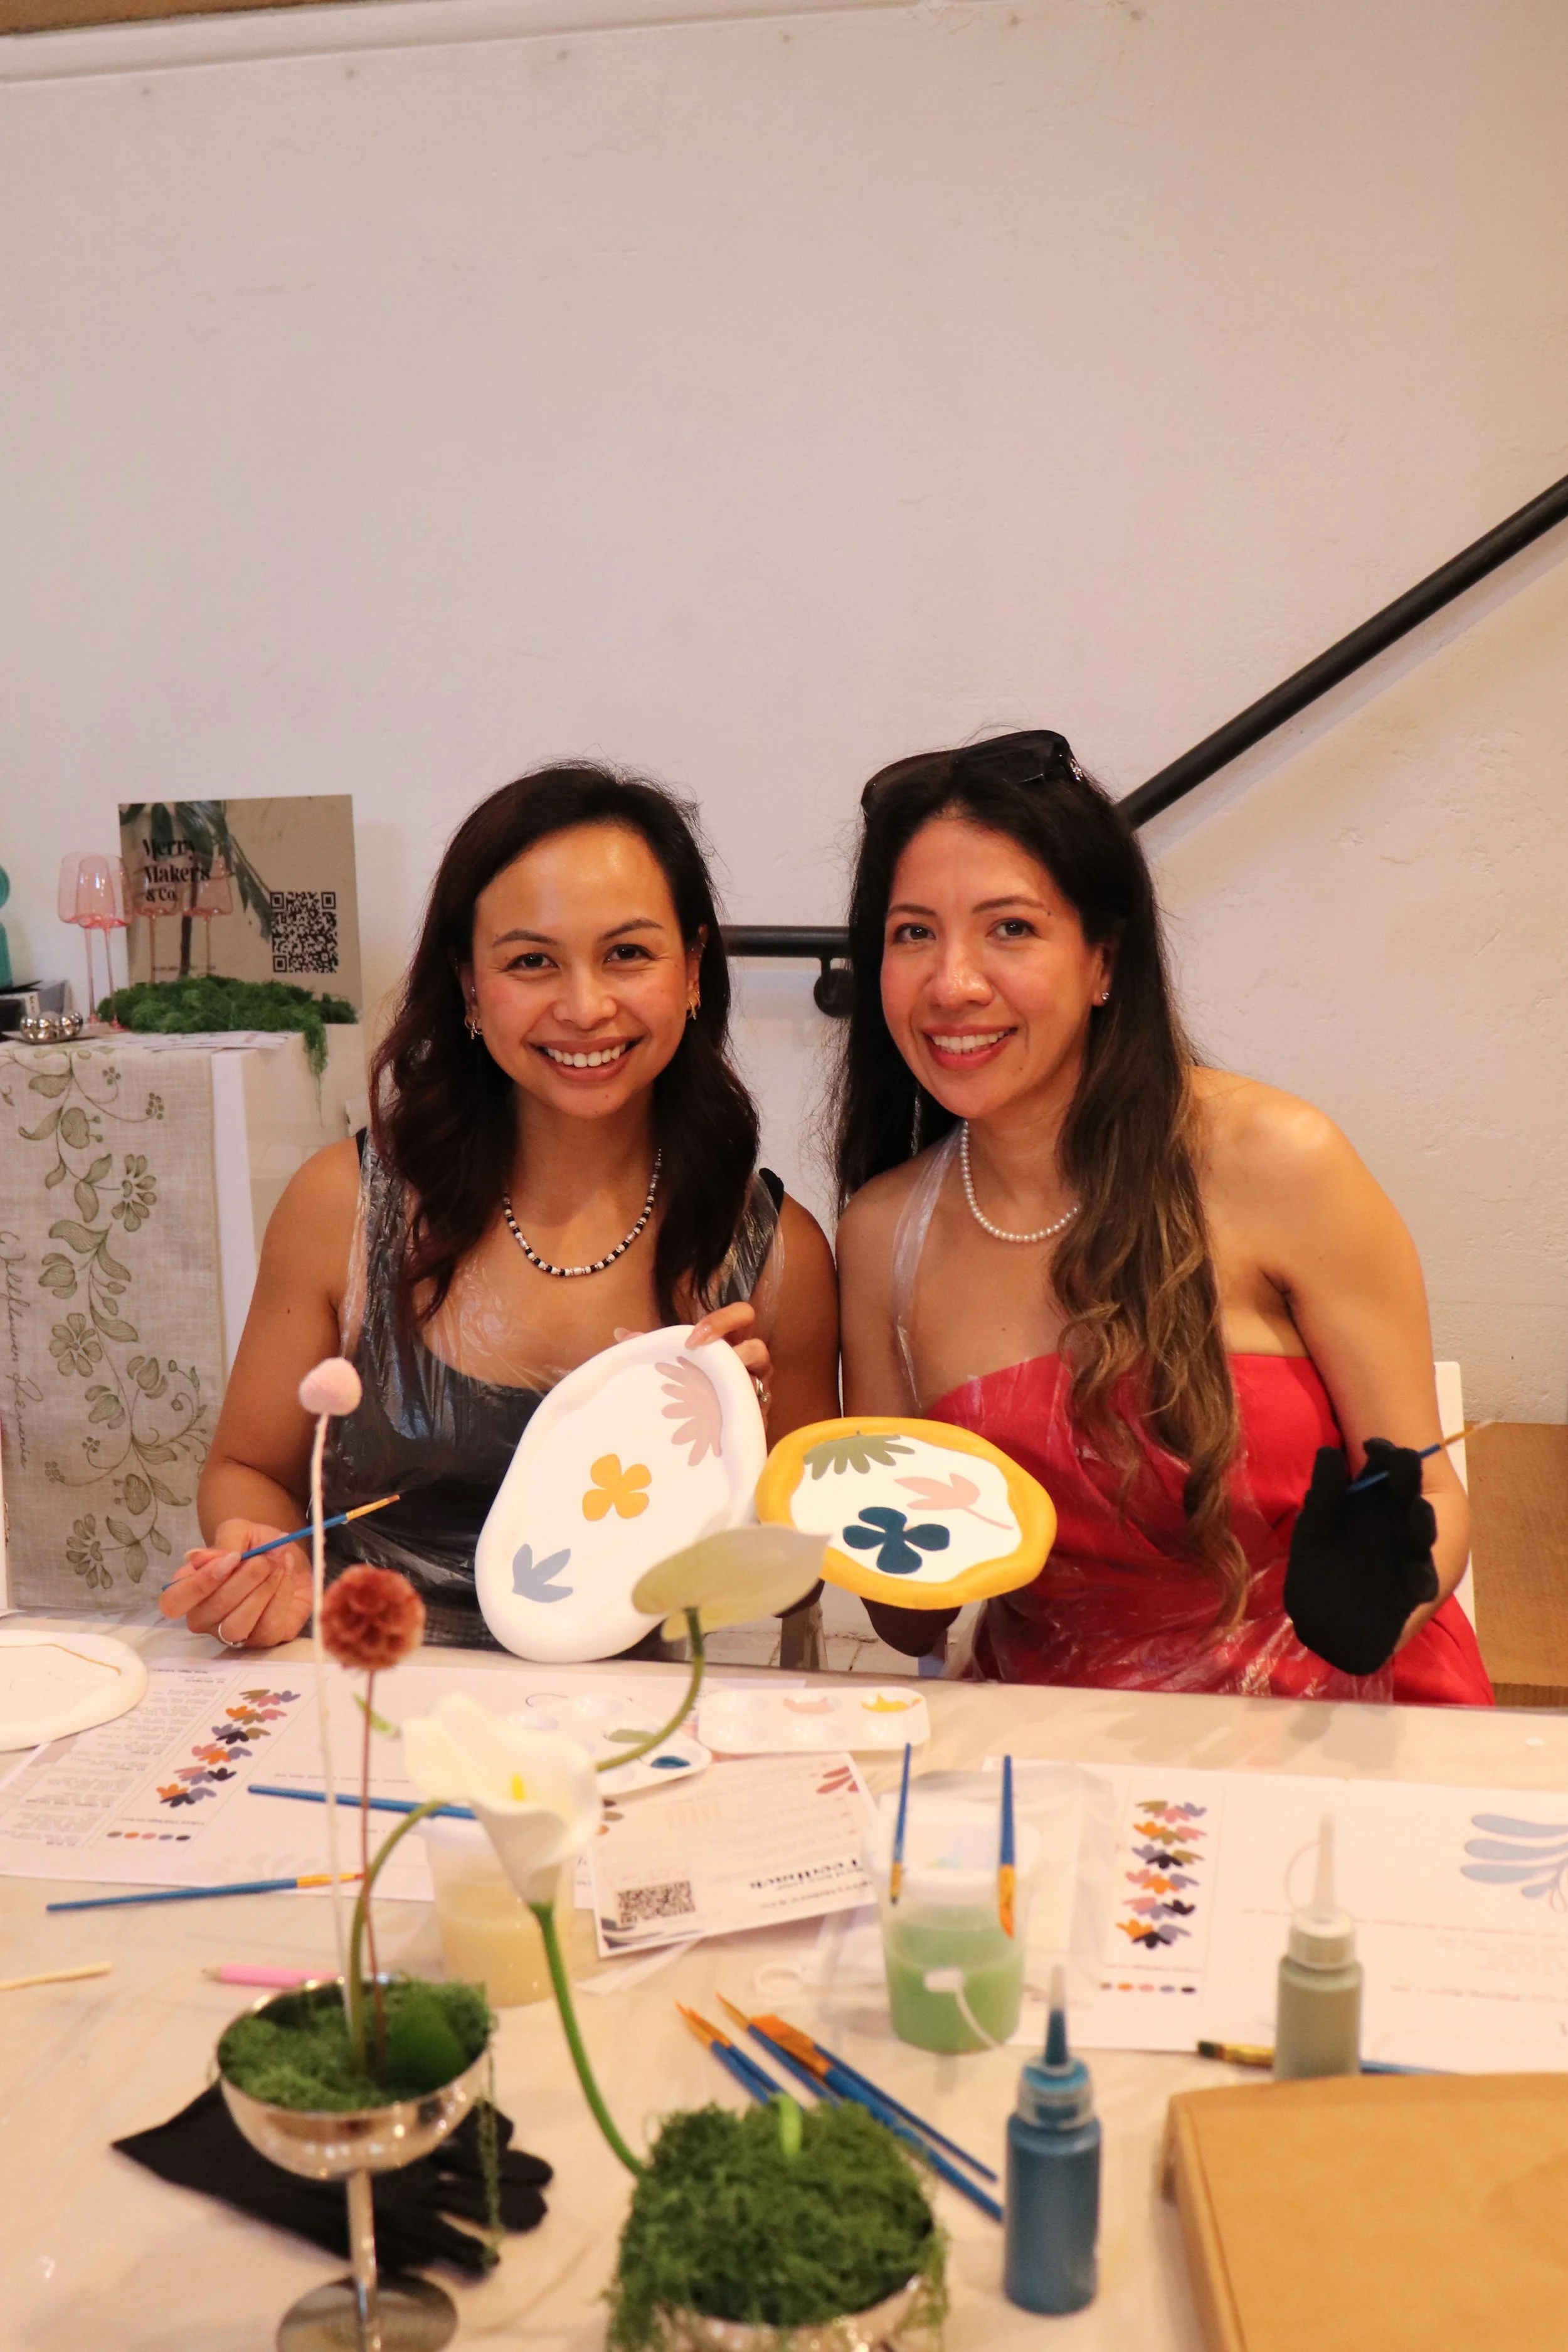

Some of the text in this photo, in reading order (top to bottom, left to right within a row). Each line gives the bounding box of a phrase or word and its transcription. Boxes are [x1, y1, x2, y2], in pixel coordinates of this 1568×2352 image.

[142, 839, 195, 860] Merry
[145, 864, 211, 883] Makers
[146, 889, 155, 903] &
